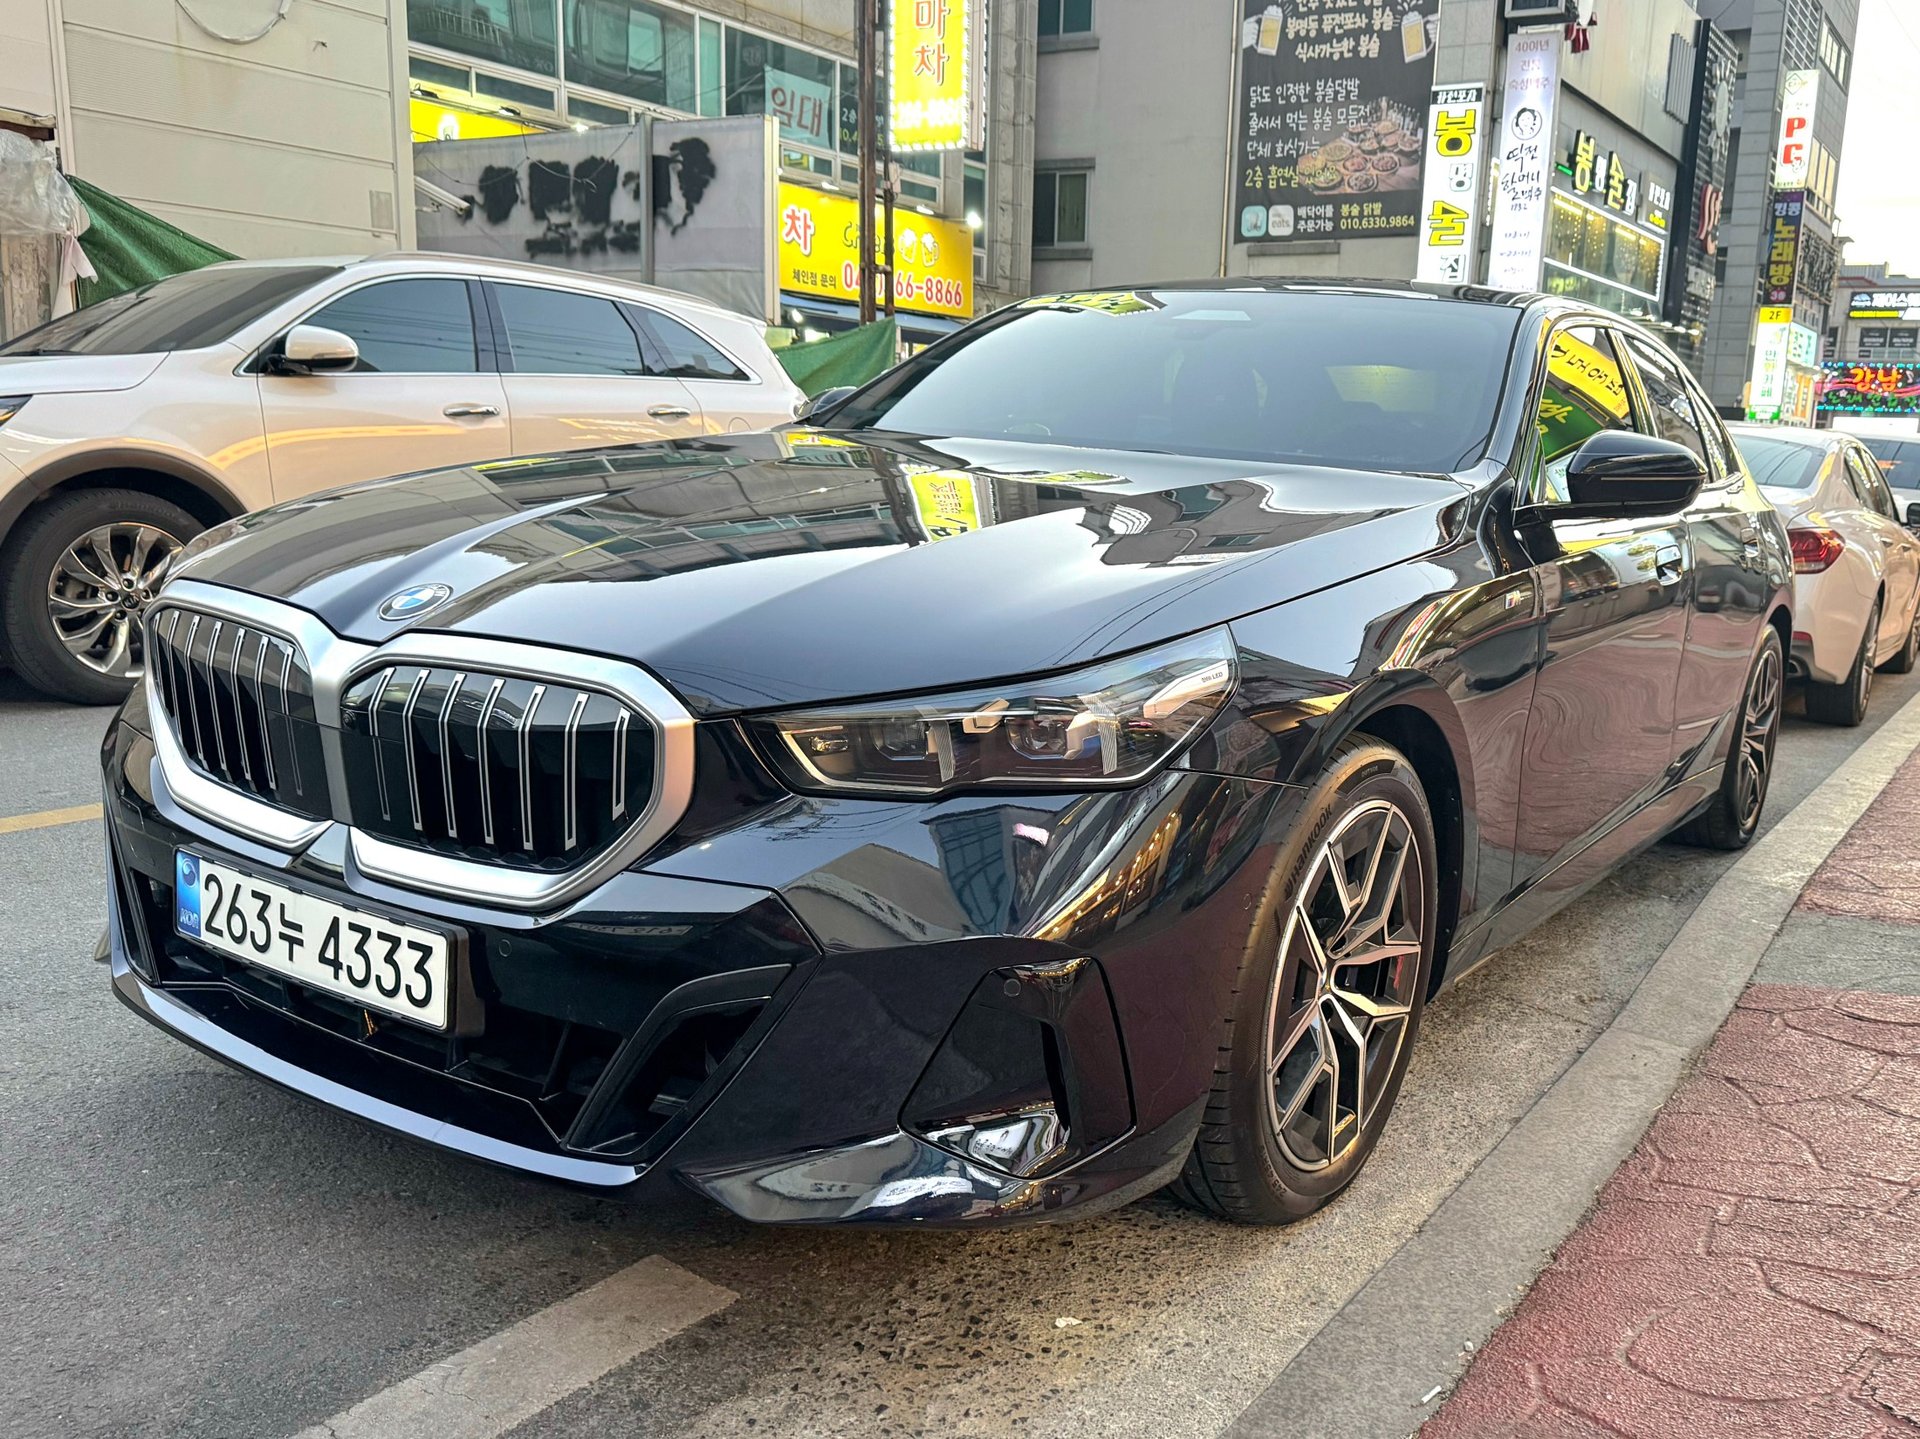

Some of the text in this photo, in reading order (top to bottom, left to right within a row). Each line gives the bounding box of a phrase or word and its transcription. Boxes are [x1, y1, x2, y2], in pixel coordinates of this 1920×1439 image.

[1286, 6, 1394, 40] 봉명동 퓨전포차 봉술
[914, 0, 951, 86] 마차
[1295, 33, 1381, 63] 식사가능한 봉술
[1249, 76, 1361, 108] 닭도 인정한 봉술달발
[771, 87, 822, 137] 임대
[1248, 104, 1371, 136] 줄서서 먹는 봉술 모듬전
[1247, 140, 1271, 160] 단체
[1245, 165, 1264, 189] 2층
[1267, 164, 1300, 189] 흡연실
[1340, 201, 1383, 217] 봉술 닭발
[1340, 214, 1416, 231] 010.6330.9864
[1297, 218, 1335, 233] 주문가능
[1768, 217, 1796, 287] 노래방
[792, 267, 838, 290] 체인점 문의
[1769, 311, 1782, 320] 2F
[1850, 366, 1903, 393] 강남
[204, 873, 434, 1009] 263누 4333
